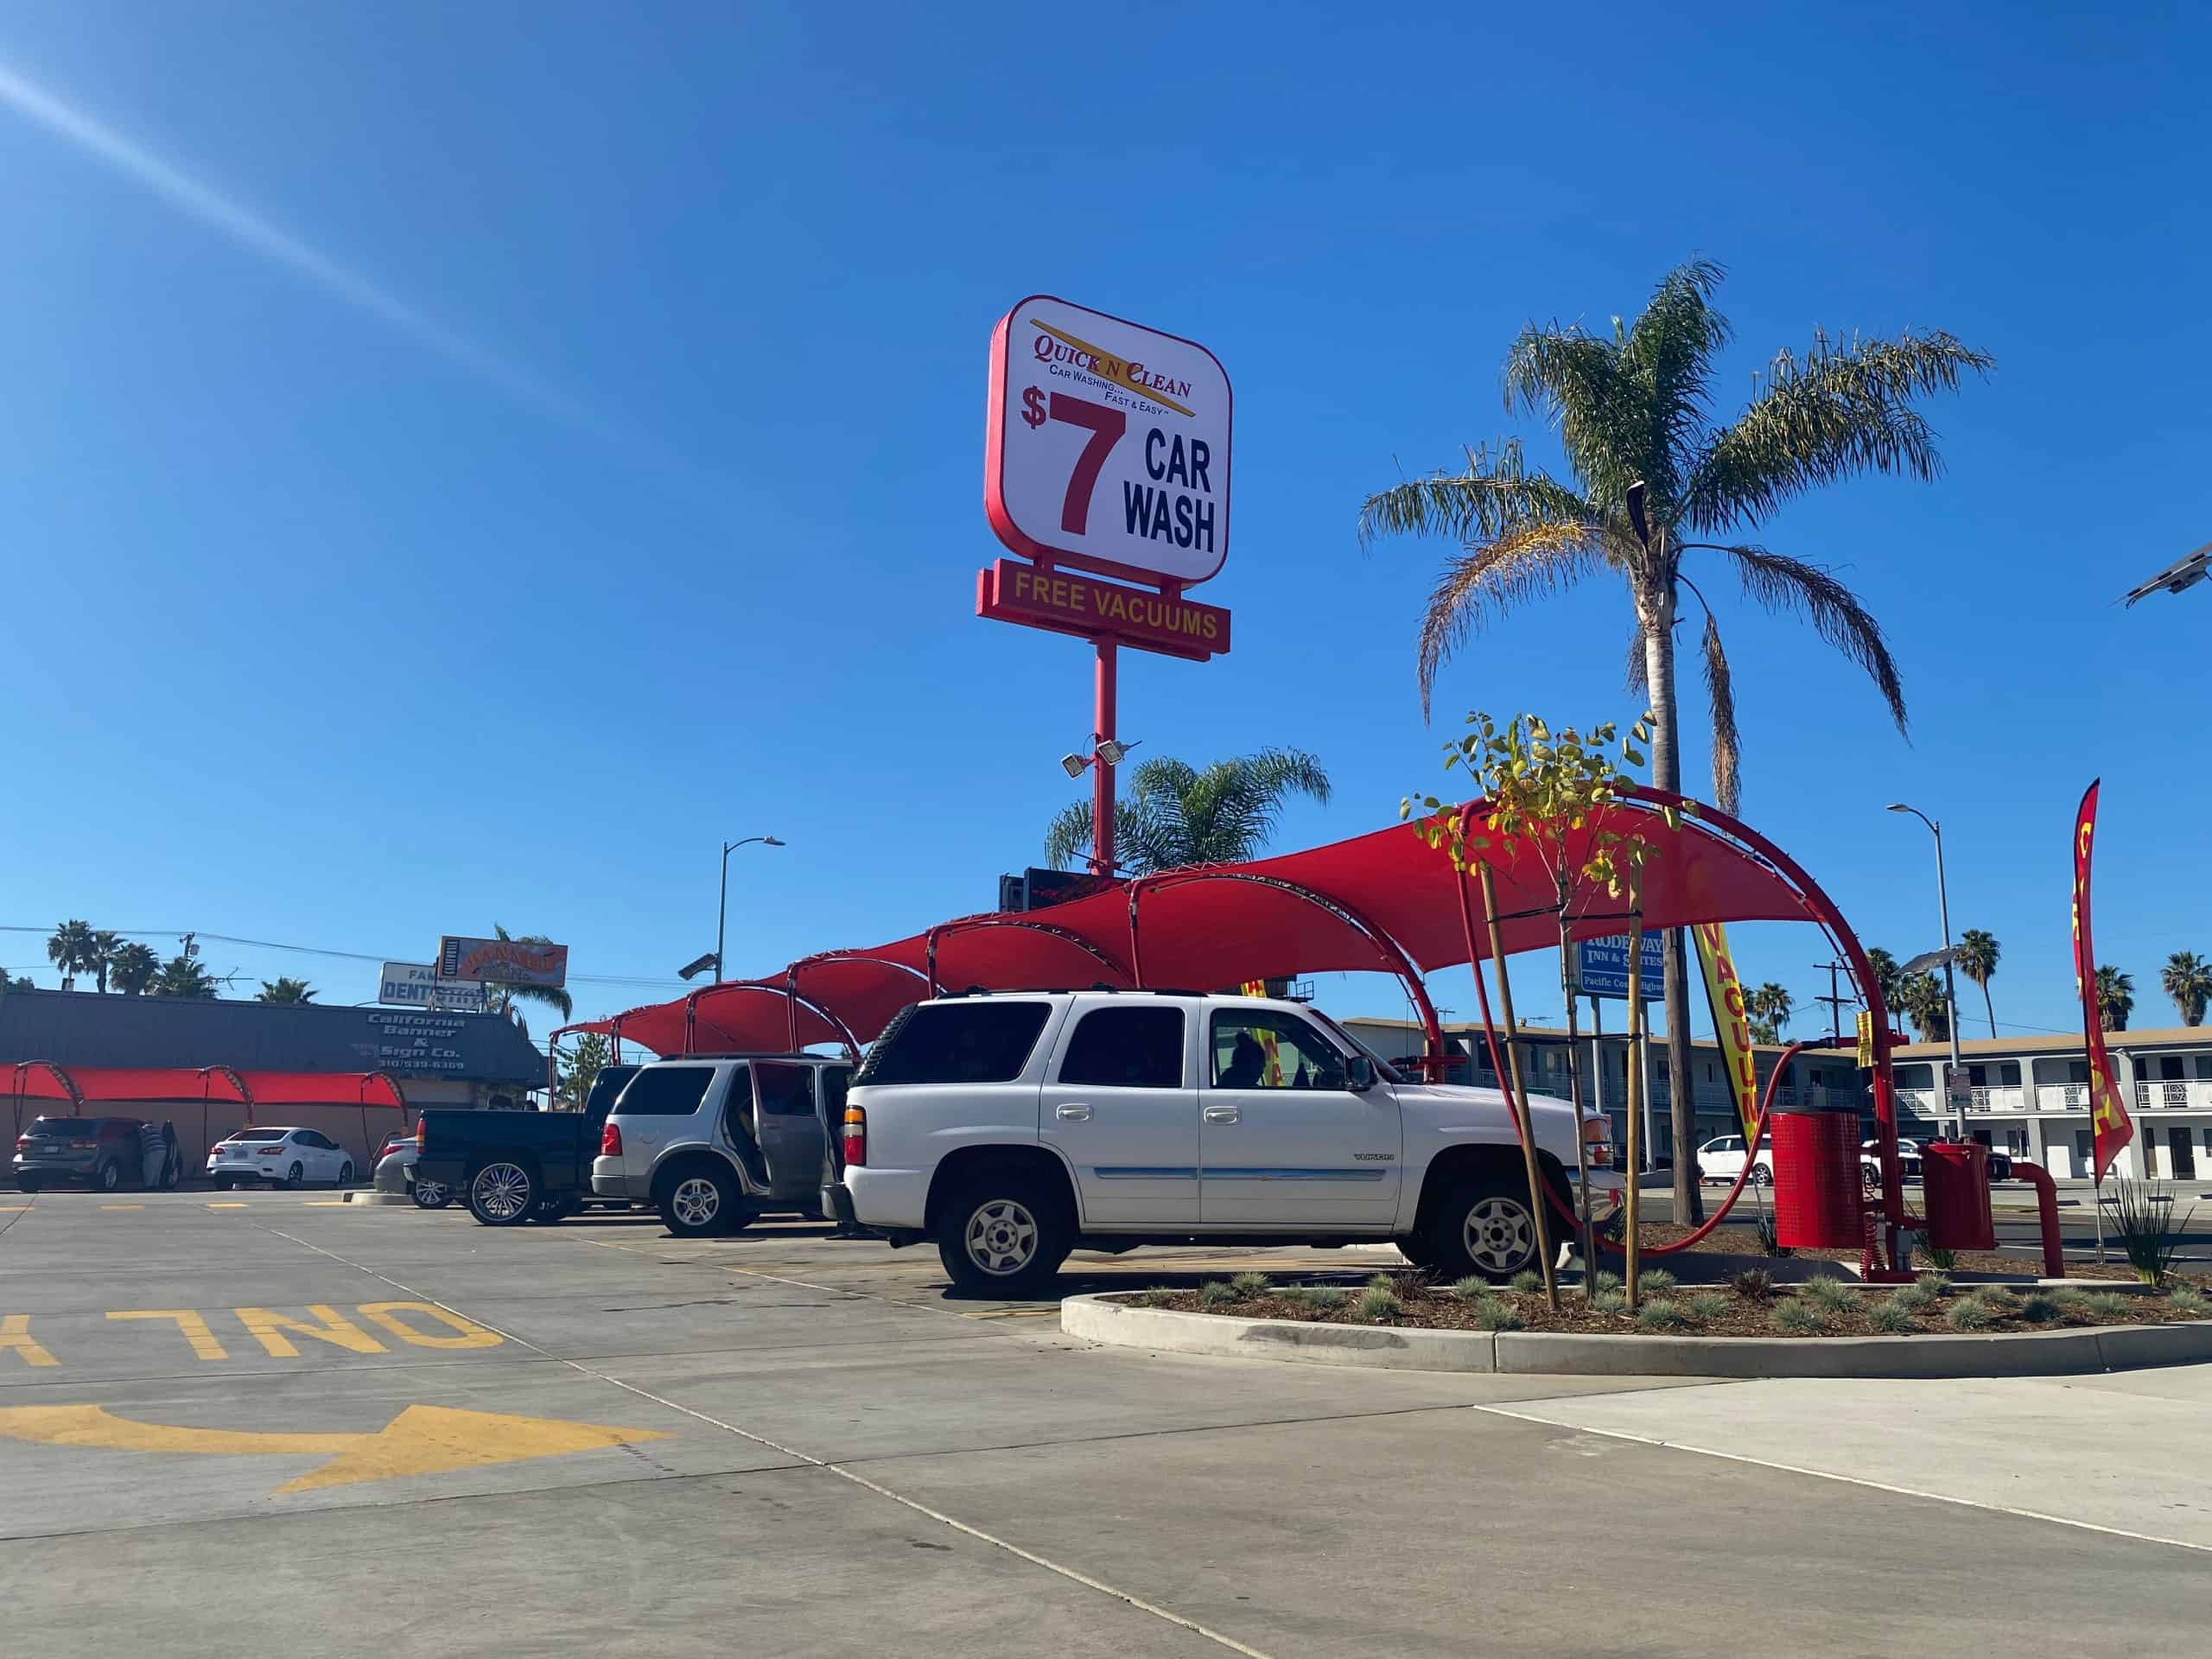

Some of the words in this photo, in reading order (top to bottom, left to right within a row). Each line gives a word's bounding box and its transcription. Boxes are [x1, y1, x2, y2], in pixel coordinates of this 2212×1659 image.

[1033, 334, 1102, 372] QUICK
[1106, 362, 1122, 378] N
[1126, 362, 1192, 398] CLEAN
[1049, 365, 1071, 379] CAR
[1104, 392, 1129, 406] FAST
[1145, 428, 1211, 493] CAR
[1123, 480, 1214, 553] WASH
[1015, 571, 1084, 611] FREE
[1093, 588, 1217, 639] VACUUMS
[1587, 950, 1610, 963] INN
[1623, 954, 1663, 968] SITES
[1584, 976, 1611, 987] Pacific
[367, 1013, 466, 1027] California
[384, 1025, 457, 1037] Banner
[414, 1038, 429, 1047] &
[380, 1046, 425, 1058] Sign
[431, 1047, 461, 1058] Co.
